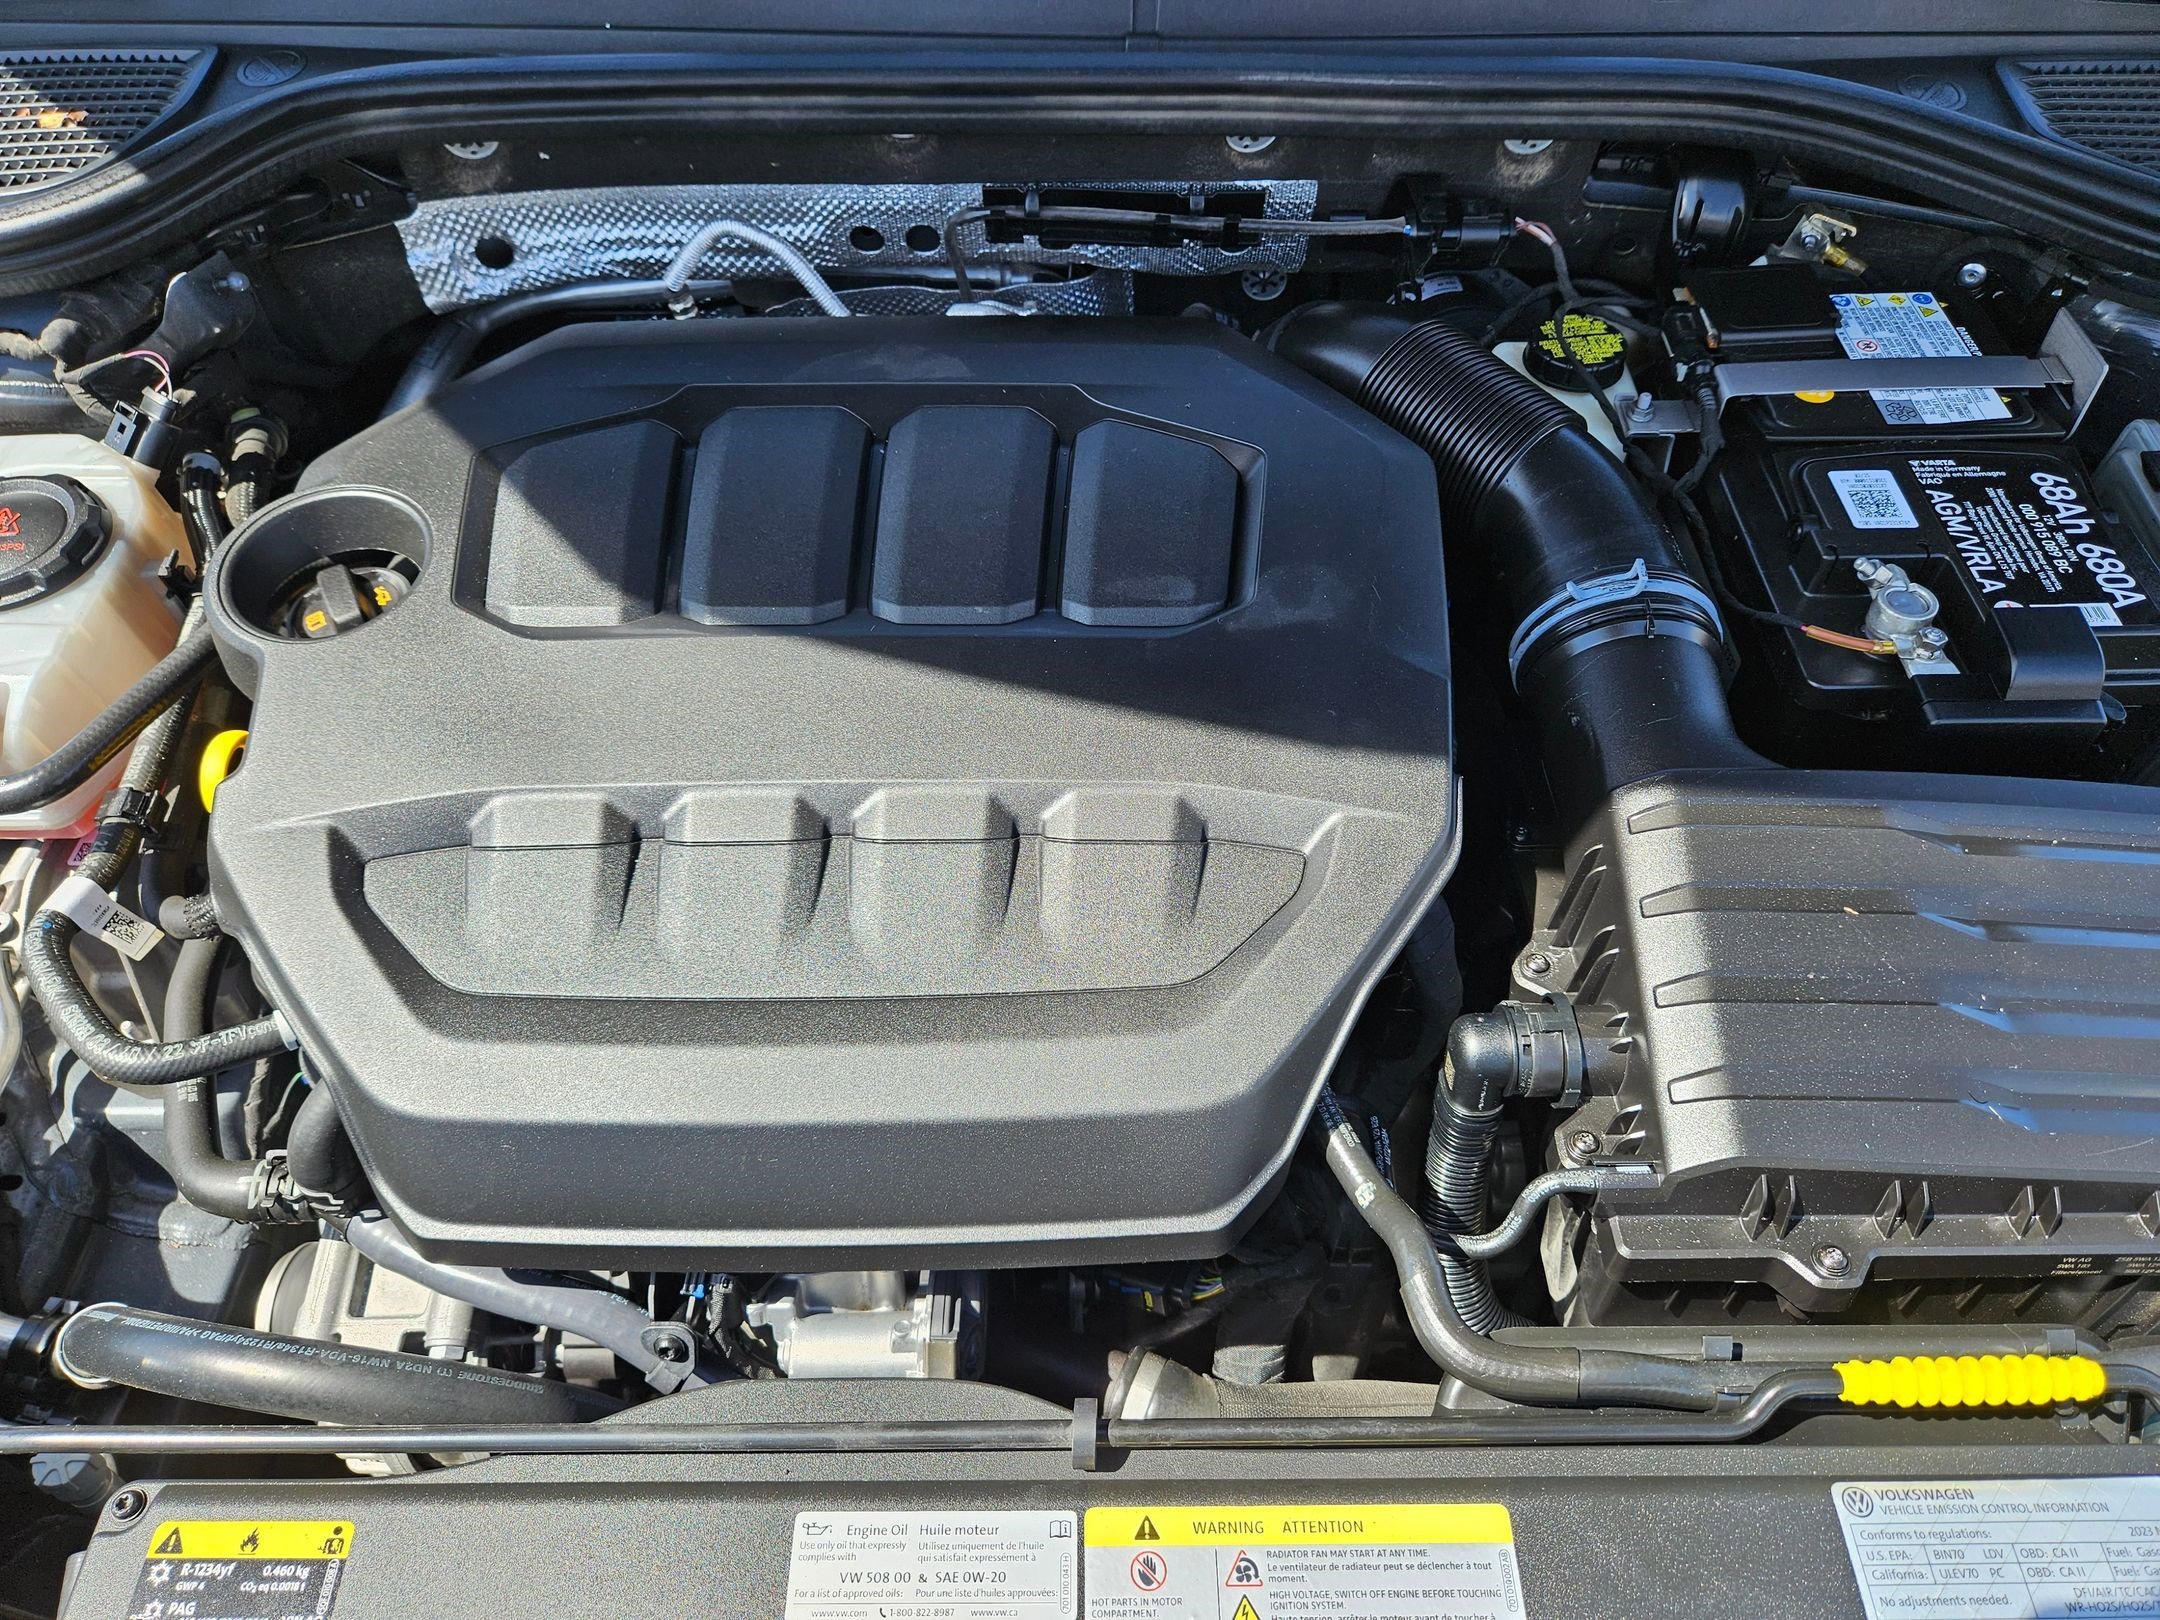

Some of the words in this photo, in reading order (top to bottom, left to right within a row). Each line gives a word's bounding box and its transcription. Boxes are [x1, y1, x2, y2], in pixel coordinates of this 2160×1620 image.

[1925, 490, 2006, 593] AGM/VRLA
[2030, 472, 2096, 534] 68Ah
[2076, 543, 2146, 608] 680A
[2042, 514, 2056, 526] 12V
[2053, 532, 2070, 548] 380A
[2064, 549, 2080, 562] DIN
[2030, 522, 2051, 538] 915
[2042, 540, 2062, 557] 089
[2052, 560, 2073, 574] BC
[1874, 1488, 1974, 1500] VOLKSWAGEN
[1880, 1504, 1924, 1515] VEHICLE
[1928, 1504, 1979, 1514] EMISSION
[1981, 1503, 2032, 1514] CONTROL
[2034, 1502, 2110, 1513] INFORMATION
[847, 1524, 888, 1539] Engine
[891, 1523, 908, 1536] Oil
[920, 1524, 951, 1536] Huile
[954, 1525, 1000, 1536] moteur
[1192, 1521, 1264, 1534] WARNING
[1282, 1520, 1364, 1534] ATTENTION
[2128, 1526, 2154, 1537] 2023
[1860, 1530, 1912, 1541] Conforms
[1914, 1530, 1926, 1540] to
[1928, 1528, 1992, 1542] regulations:
[800, 1541, 816, 1550] Use
[816, 1541, 834, 1552] only
[836, 1541, 848, 1550] oil
[849, 1541, 866, 1550] that
[868, 1541, 907, 1552] expressly
[918, 1542, 950, 1550] Utilisez
[952, 1542, 1003, 1553] uniquement
[1005, 1542, 1016, 1550] de
[1018, 1542, 1044, 1550] l'huile
[2106, 1546, 2132, 1558] Fuel:
[798, 1553, 836, 1564] complies
[838, 1553, 857, 1562] with
[918, 1554, 932, 1564] qui
[933, 1552, 967, 1562] satisfait
[969, 1552, 1030, 1564] expressément
[1031, 1552, 1036, 1562] à
[1266, 1550, 1308, 1559] RADIATOR
[1311, 1550, 1328, 1558] FAN
[1330, 1550, 1348, 1558] MAY
[1350, 1550, 1374, 1558] START
[1377, 1550, 1387, 1558] AT
[1389, 1549, 1406, 1558] ANY
[1408, 1548, 1431, 1558] TIME.
[1866, 1550, 1888, 1561] U.S.
[1889, 1550, 1912, 1561] EPA:
[1933, 1550, 1965, 1560] BIN70
[1983, 1549, 2004, 1560] LDV
[2020, 1548, 2048, 1558] OBD:
[181, 1562, 236, 1580] R-1234yf
[263, 1564, 294, 1577] 0.460
[296, 1564, 310, 1580] kg
[1268, 1563, 1278, 1572] Le
[1279, 1563, 1326, 1572] ventilateur
[1329, 1562, 1339, 1571] de
[1342, 1562, 1381, 1571] radiateur
[1384, 1562, 1402, 1572] peut
[1417, 1561, 1464, 1570] déclencher
[1466, 1561, 1472, 1570] à
[1474, 1562, 1492, 1570] tout
[2114, 1566, 2140, 1576] Fuel:
[840, 1572, 863, 1584] VW
[866, 1572, 890, 1584] 508
[894, 1572, 912, 1584] 00
[918, 1573, 928, 1584] &
[936, 1572, 959, 1584] SAE
[962, 1571, 1007, 1584] 0W-20
[1872, 1570, 1928, 1580] California:
[1939, 1568, 1978, 1579] ULEV70
[1990, 1568, 2006, 1578] PC
[2026, 1568, 2056, 1578] OBD:
[1268, 1575, 1308, 1583] moment.
[176, 1582, 198, 1591] GWP
[794, 1588, 808, 1598] For
[810, 1590, 816, 1598] a
[818, 1588, 830, 1598] list
[832, 1588, 842, 1598] of
[843, 1588, 884, 1600] approved
[886, 1588, 904, 1598] oils:
[916, 1588, 936, 1598] Pour
[936, 1590, 952, 1598] une
[954, 1588, 972, 1598] liste
[973, 1588, 1006, 1598] d'huiles
[1007, 1588, 1058, 1600] approuvées:
[1270, 1591, 1290, 1600] HIGH
[1292, 1590, 1332, 1600] VOLTAGE,
[1335, 1590, 1368, 1599] SWITCH
[1369, 1590, 1386, 1598] OFF
[1388, 1590, 1420, 1598] ENGINE
[1422, 1590, 1456, 1598] BEFORE
[1458, 1590, 1502, 1598] TOUCHING
[1092, 1598, 1109, 1606] HOT
[1112, 1598, 1138, 1606] PARTS
[1140, 1598, 1149, 1606] IN
[1152, 1598, 1183, 1606] MOTOR
[1270, 1602, 1308, 1610] IGNITION
[1311, 1601, 1346, 1610] SYSTEM.
[1879, 1596, 1896, 1608] No
[1899, 1596, 1967, 1610] adjustments
[1970, 1594, 2012, 1606] needed.
[168, 1602, 196, 1615] PAG
[811, 1608, 868, 1618] www.vw.com
[890, 1608, 955, 1618] 1-800-822-8987
[970, 1608, 1018, 1617] www.vw.ca
[1092, 1610, 1160, 1618] COMPARTMENT.
